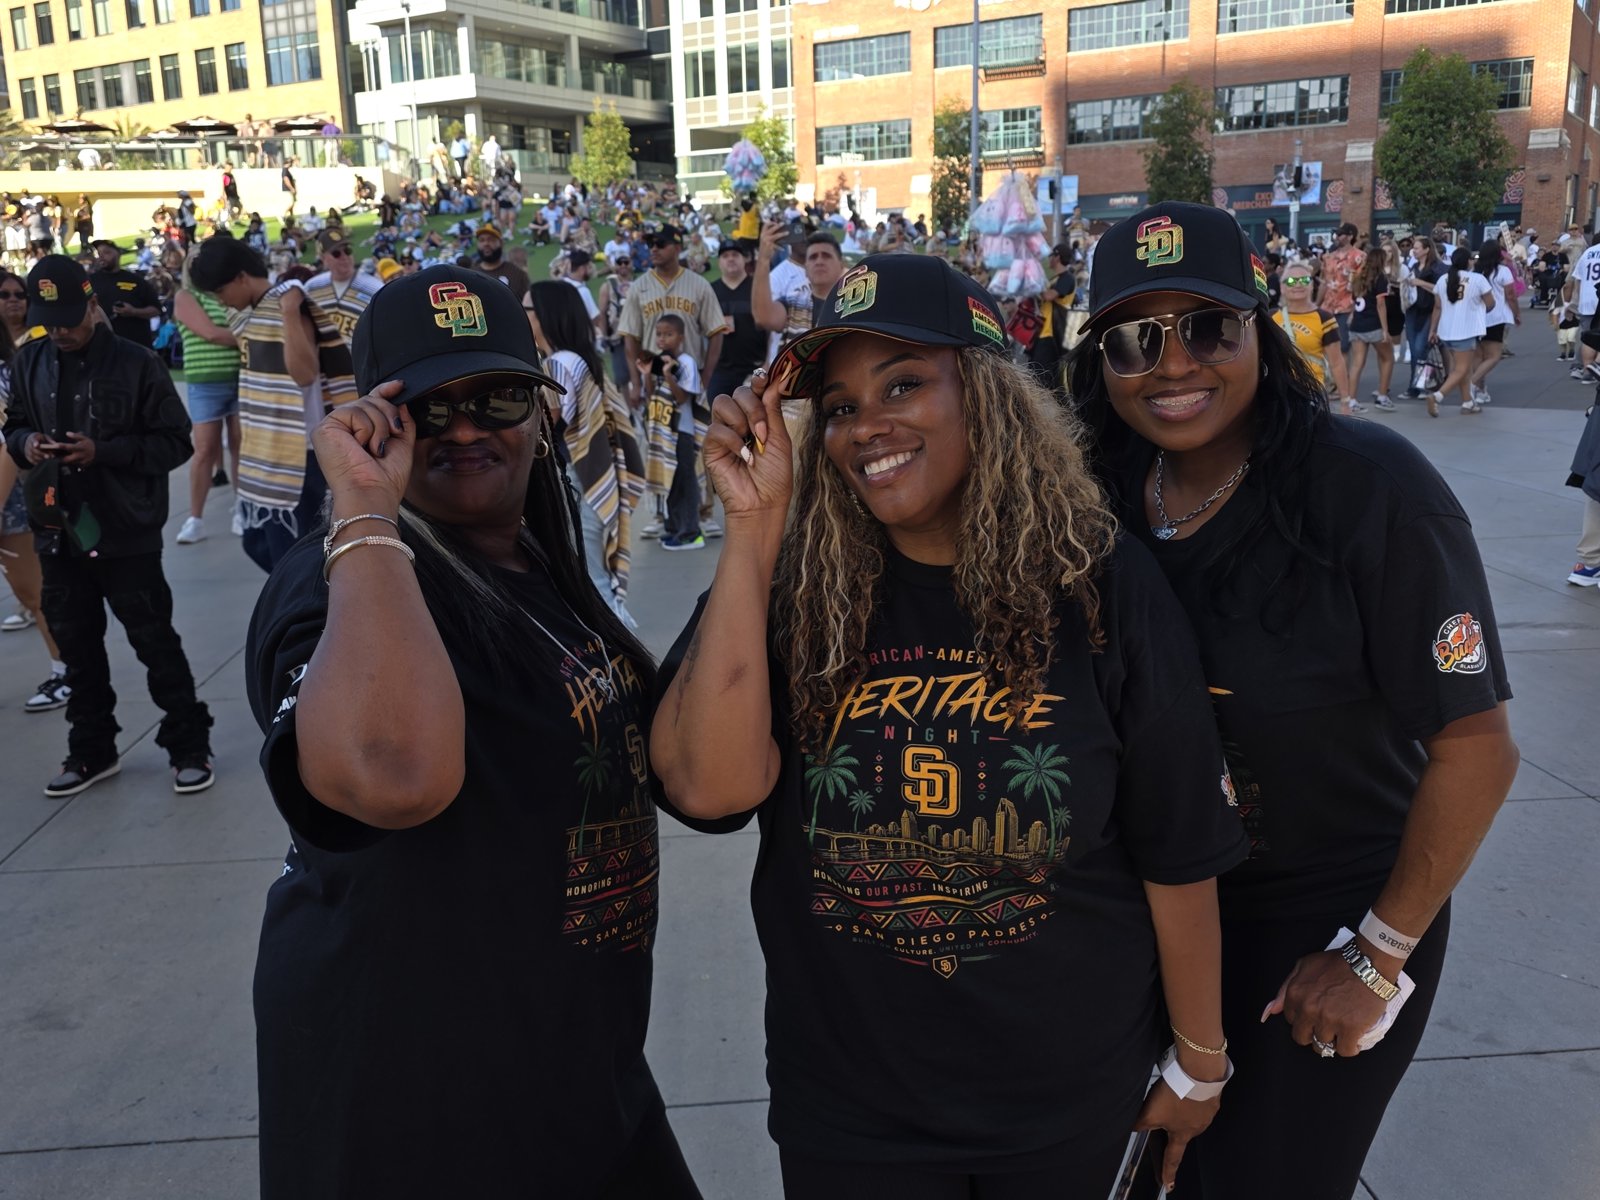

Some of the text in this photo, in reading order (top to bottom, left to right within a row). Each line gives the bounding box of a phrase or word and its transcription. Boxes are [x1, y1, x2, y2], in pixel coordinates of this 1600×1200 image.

[1136, 215, 1184, 267] SD
[1586, 262, 1600, 281] 19
[38, 278, 60, 301] SD
[834, 264, 879, 319] SD
[428, 281, 488, 338] SD
[643, 297, 697, 319] SAN DIEGO
[884, 725, 980, 745] NIGHT
[901, 743, 961, 818] SD
[566, 877, 612, 896] HONORING
[866, 886, 889, 896] OUR
[894, 882, 927, 895] PAST.
[932, 880, 989, 897] INSPIRING
[596, 926, 619, 943] SAN
[852, 917, 1036, 946] SAN DIEGO PADRES
[894, 946, 936, 956] CULTURE.
